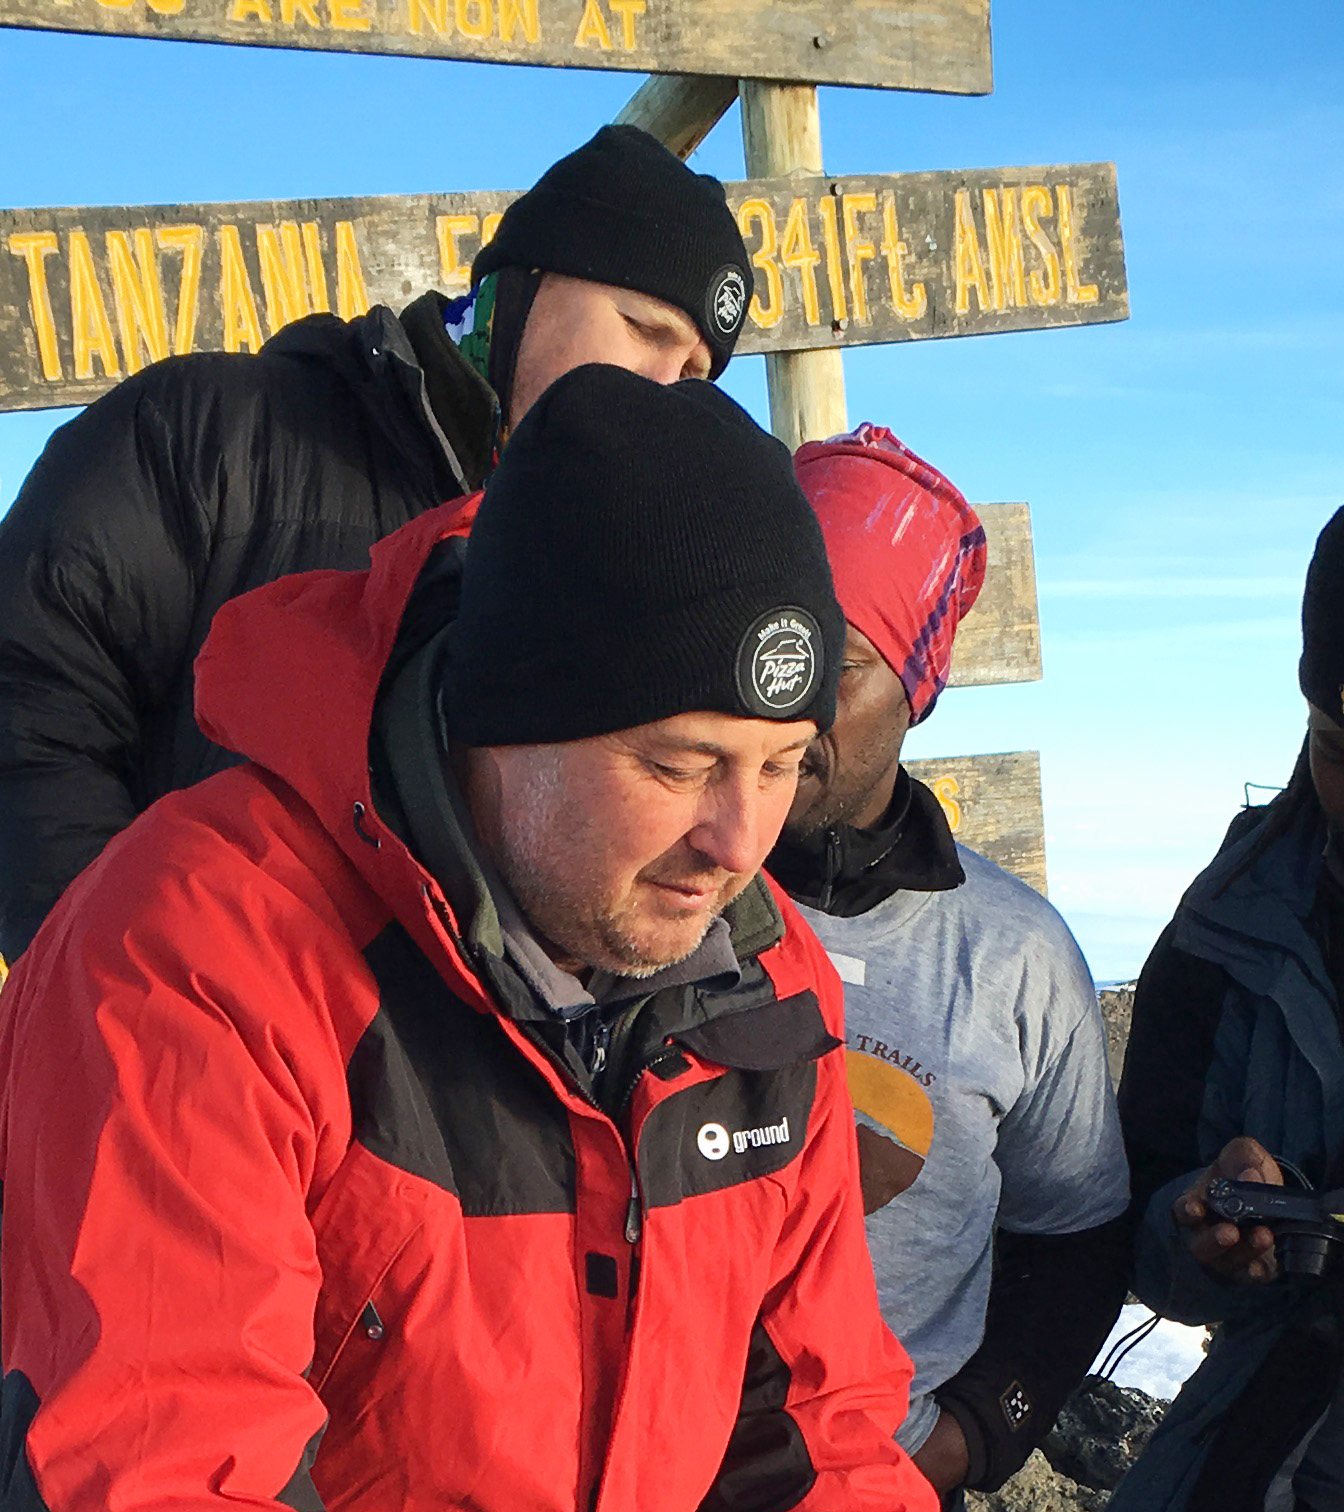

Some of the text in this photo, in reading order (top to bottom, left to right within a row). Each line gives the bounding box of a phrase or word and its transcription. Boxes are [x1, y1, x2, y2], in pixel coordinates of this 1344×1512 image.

[407, 0, 541, 43] NOW
[574, 0, 646, 49] AT
[8, 221, 369, 381] TANZANIA
[954, 184, 1099, 314] AMSL
[760, 658, 805, 684] Pizza
[766, 674, 802, 698] Hut
[857, 1034, 937, 1088] TRAILS
[733, 1116, 790, 1154] ground
